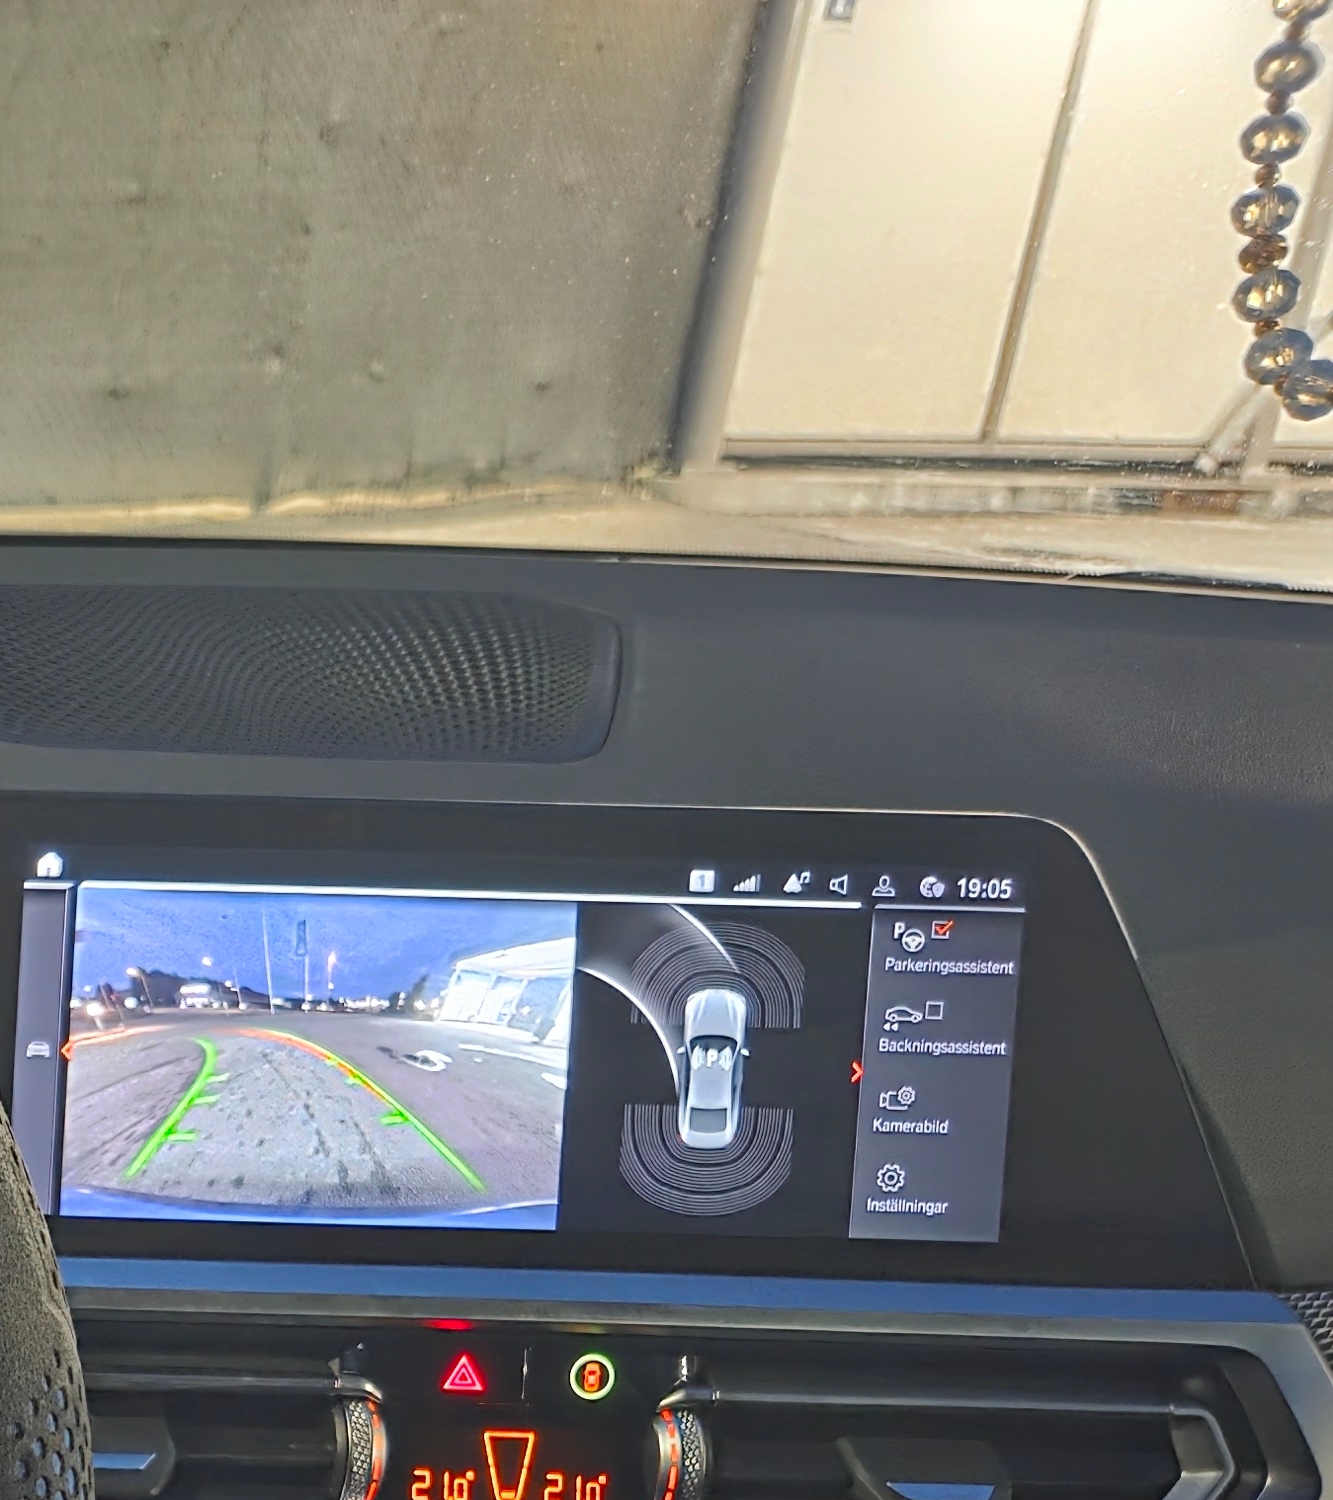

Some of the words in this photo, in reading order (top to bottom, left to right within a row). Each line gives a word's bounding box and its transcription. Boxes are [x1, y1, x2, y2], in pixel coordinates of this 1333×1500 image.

[956, 877, 1013, 900] 19:05
[884, 957, 1015, 977] Parkeringsassistent
[878, 1038, 1007, 1057] Backningsassistent
[873, 1118, 949, 1135] Kamerabild
[866, 1198, 949, 1216] Inställningar
